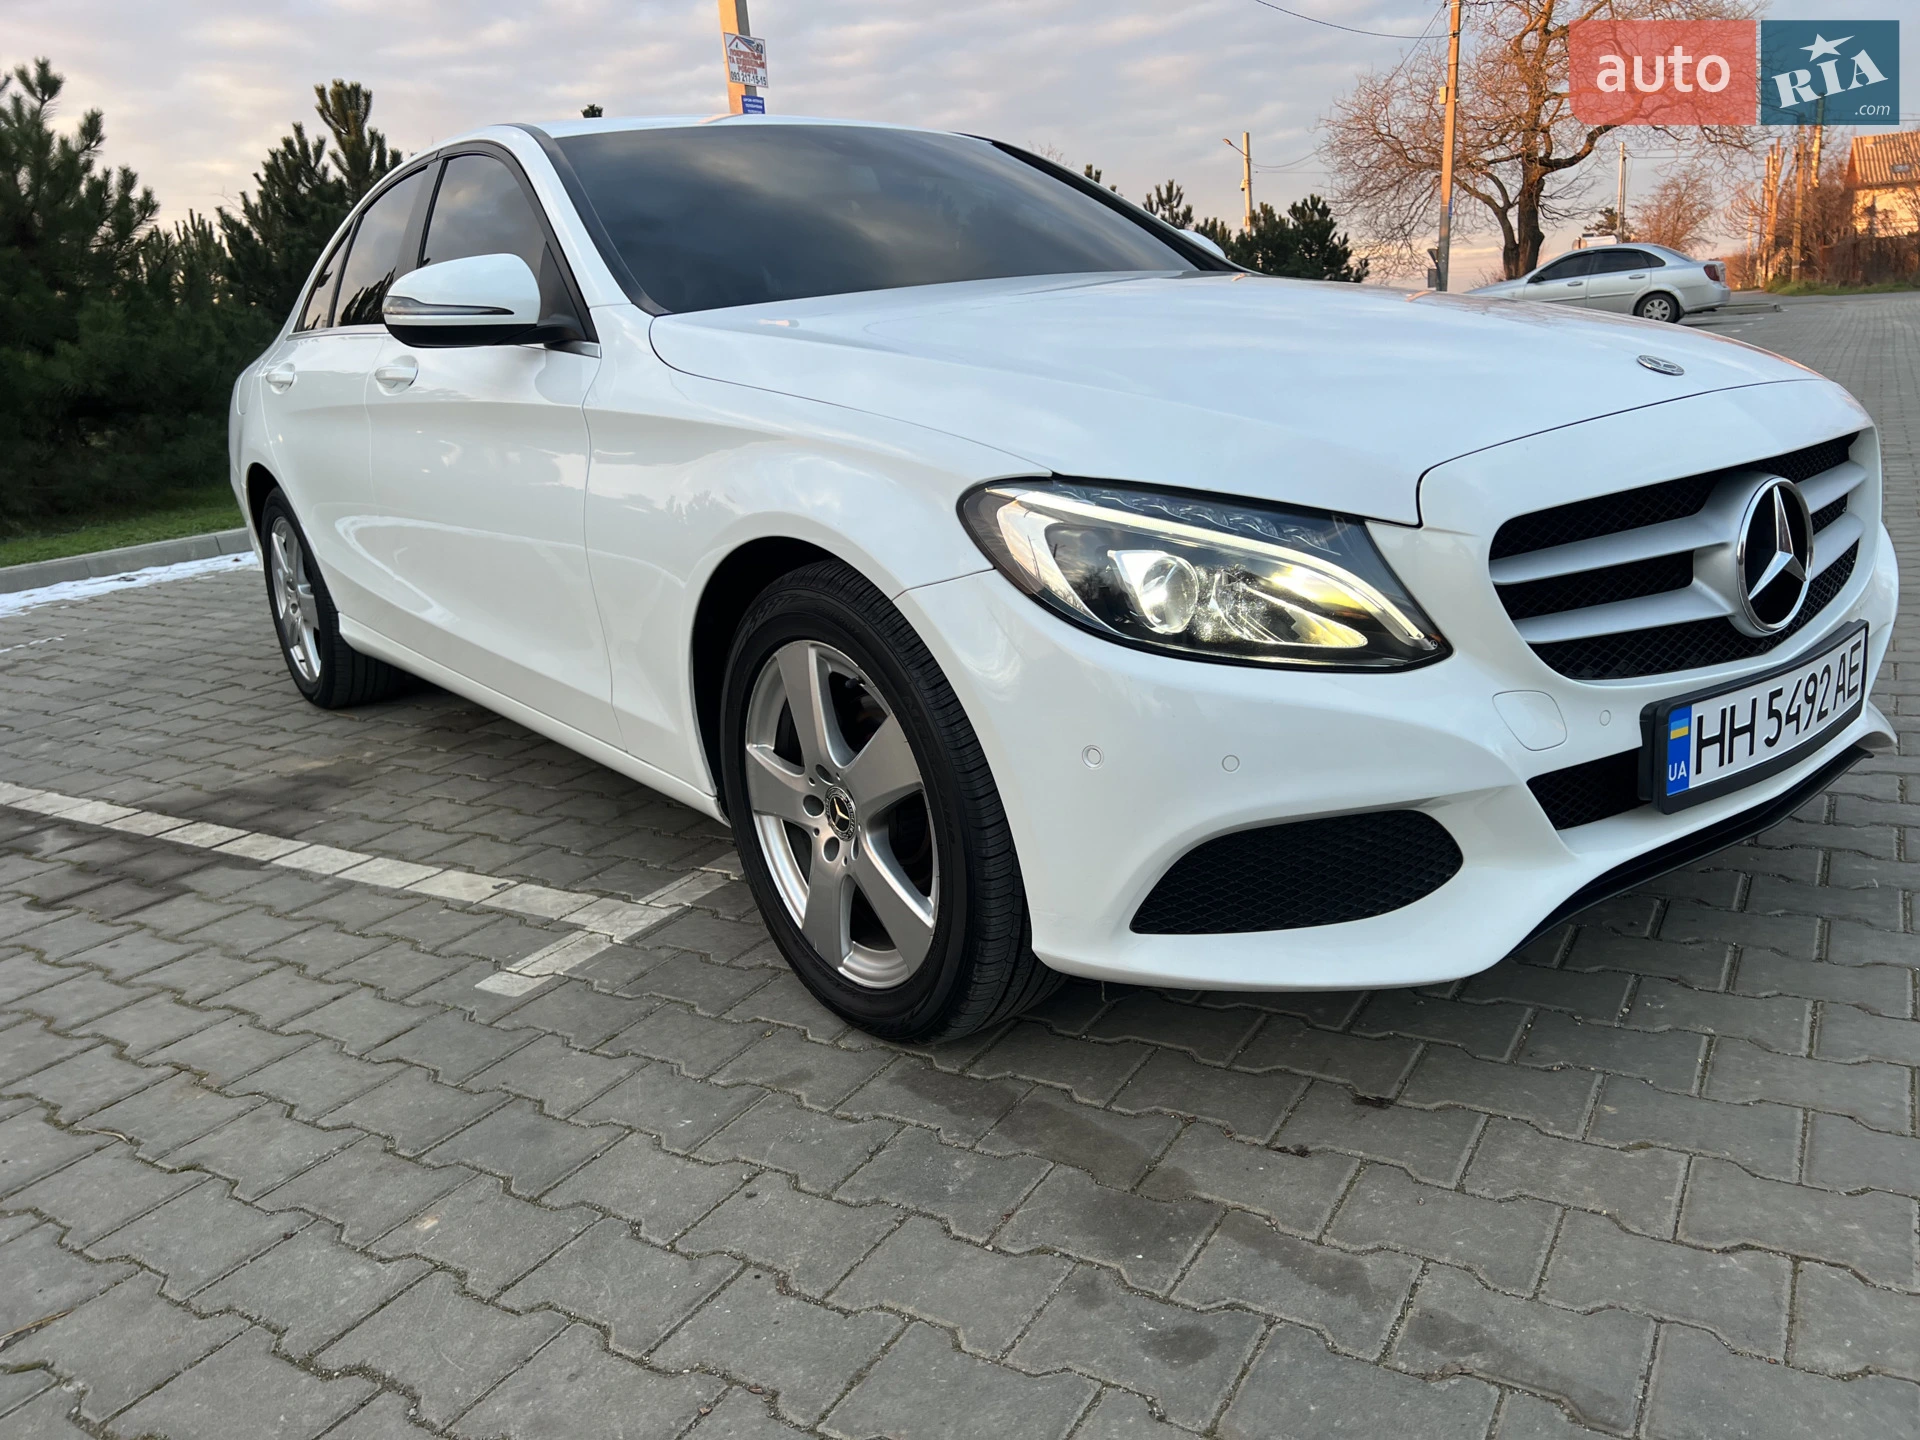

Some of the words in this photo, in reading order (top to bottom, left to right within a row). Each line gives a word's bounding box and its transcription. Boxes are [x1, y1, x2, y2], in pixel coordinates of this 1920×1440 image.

[1695, 697, 1758, 775] HH
[1763, 664, 1832, 748] 5492
[1833, 638, 1862, 711] AE
[1668, 760, 1687, 782] UA
